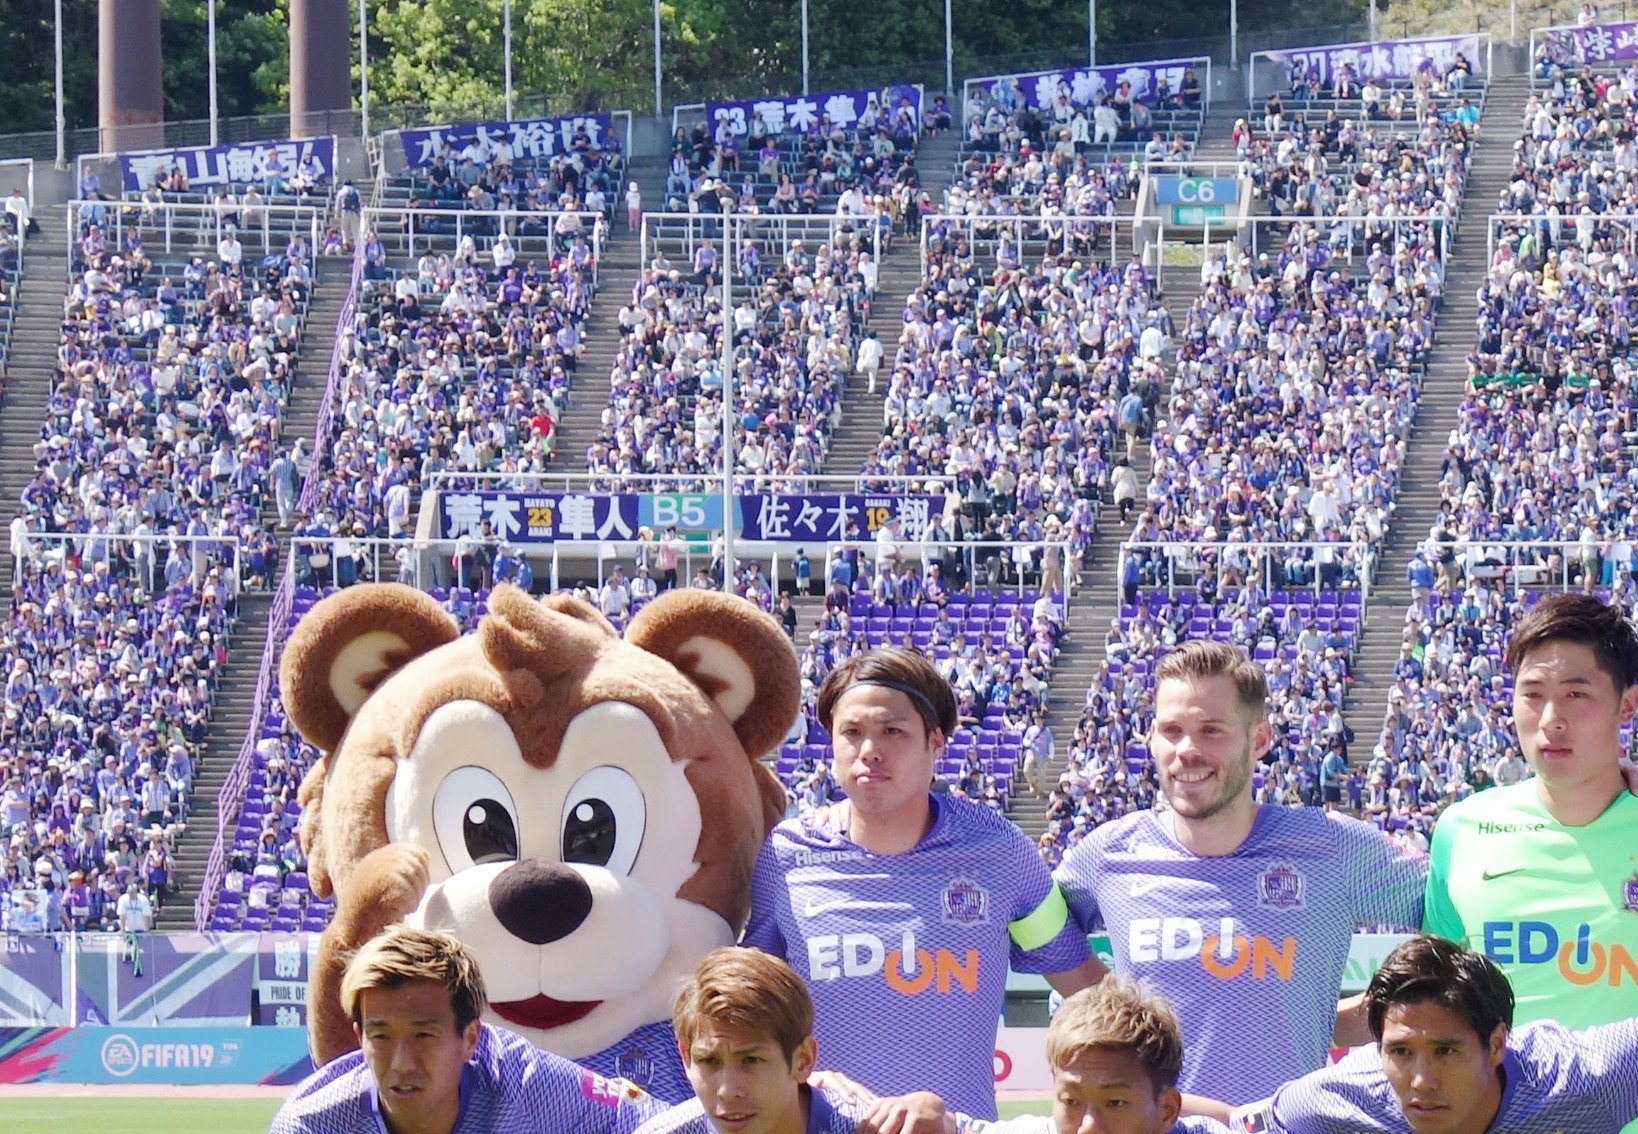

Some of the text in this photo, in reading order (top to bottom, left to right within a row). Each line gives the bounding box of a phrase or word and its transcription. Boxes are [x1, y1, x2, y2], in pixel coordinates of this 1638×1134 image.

[1178, 179, 1215, 202] C6
[446, 493, 522, 541] 荒木
[526, 507, 553, 527] 23
[559, 493, 633, 541] 隼人
[653, 496, 706, 526] B5
[756, 494, 859, 541] 佐々木
[1478, 820, 1545, 835] Hisense
[806, 929, 979, 994] EDION
[1127, 916, 1298, 982] EDION
